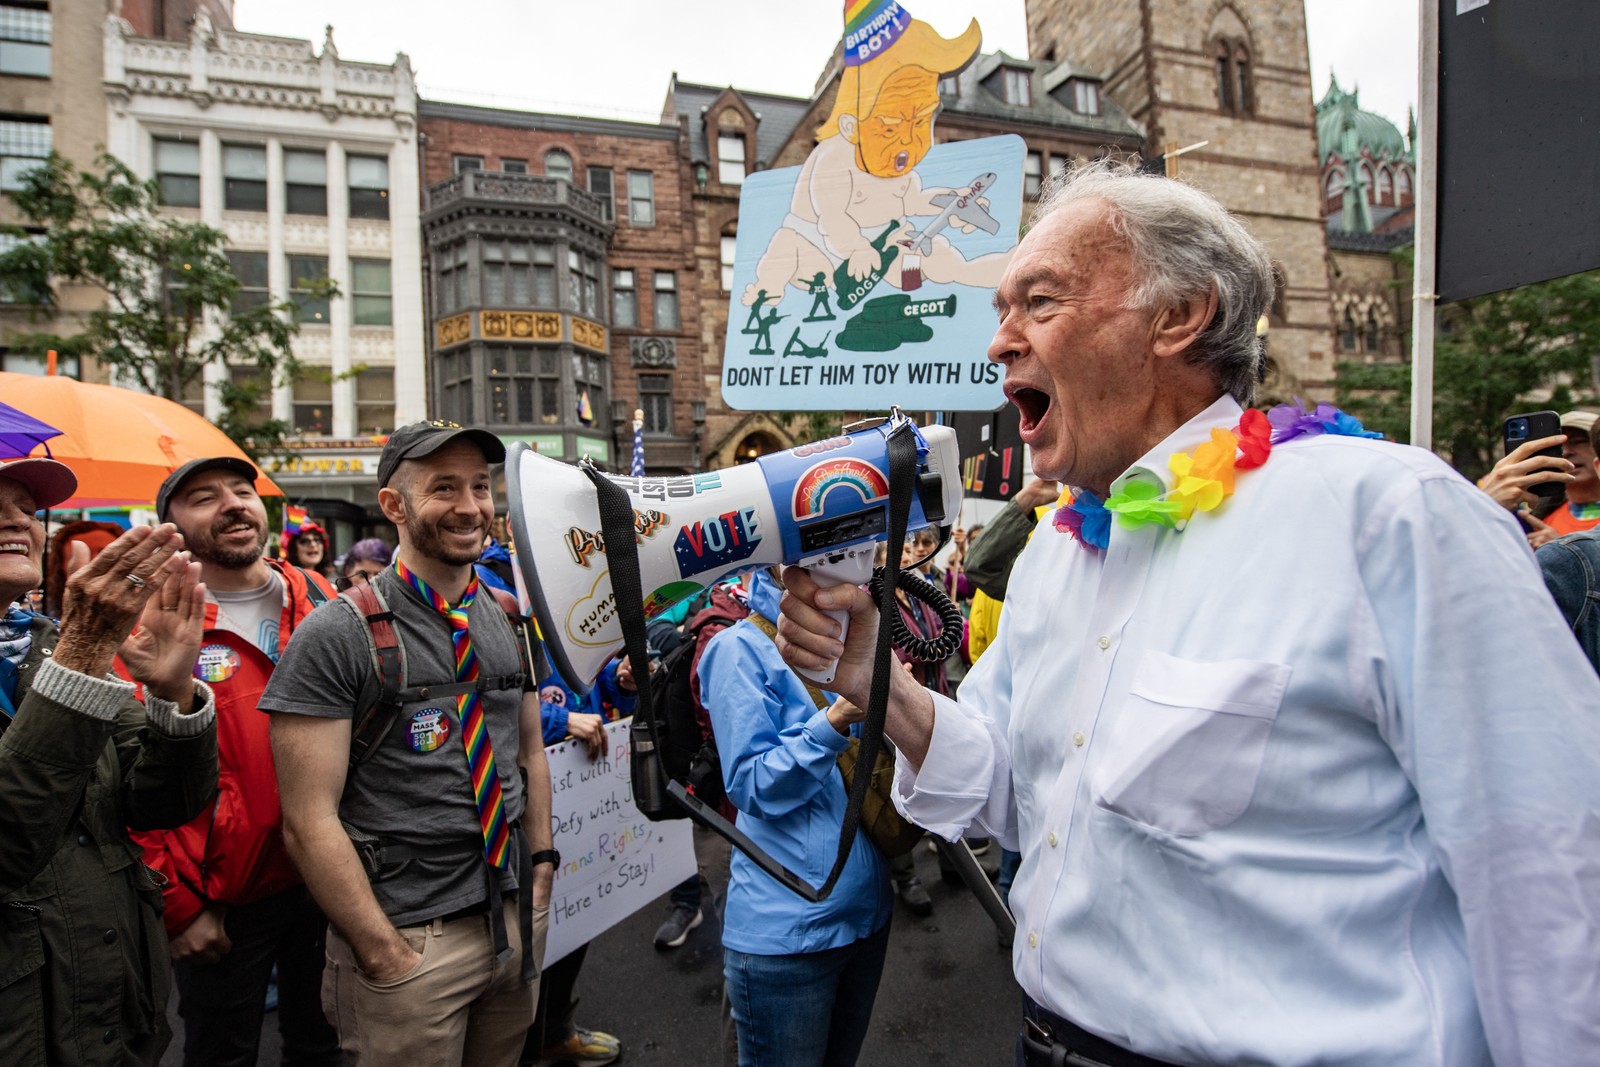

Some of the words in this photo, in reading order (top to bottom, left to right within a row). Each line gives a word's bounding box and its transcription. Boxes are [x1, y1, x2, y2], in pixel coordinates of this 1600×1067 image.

[845, 1, 900, 50] BIRTHDAY
[956, 181, 985, 210] QATAR
[848, 272, 881, 304] DOGE
[903, 300, 946, 317] CECOT
[727, 366, 774, 387] DONT
[779, 365, 814, 386] LET
[820, 365, 855, 386] HIM
[862, 364, 900, 385] TOY
[908, 363, 961, 384] WITH
[970, 363, 999, 385] US
[681, 505, 763, 558] VOTE
[579, 592, 616, 633] HUMA
[413, 721, 435, 731] MASS
[414, 732, 426, 740] 50
[425, 731, 435, 744] 1
[414, 739, 426, 747] 50
[553, 769, 573, 794] ist
[580, 756, 611, 782] with
[551, 811, 583, 838] Defy
[590, 791, 620, 820] with
[554, 896, 592, 925] Here
[597, 882, 613, 898] to
[617, 853, 655, 888] Stay!
